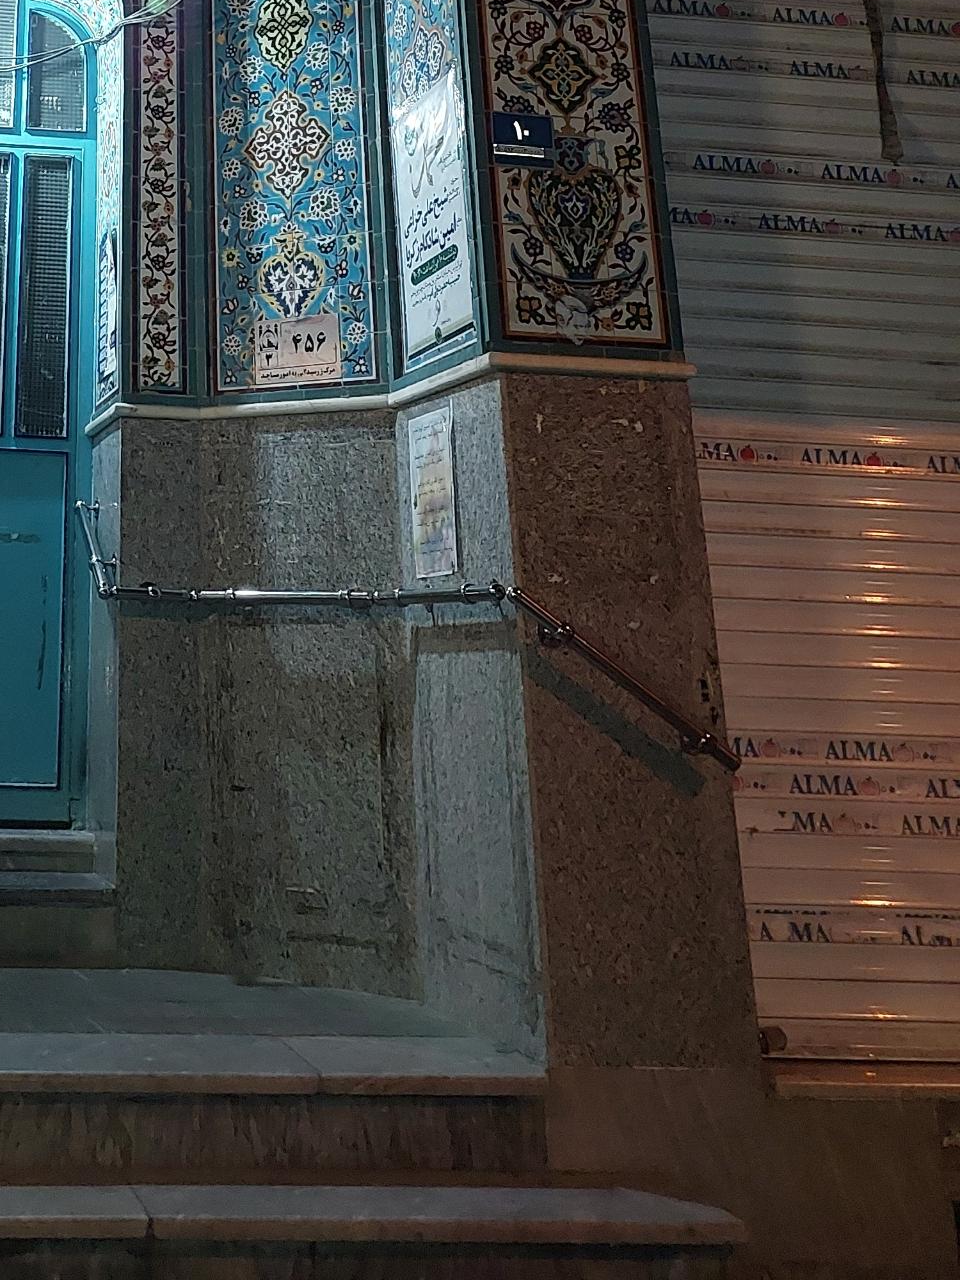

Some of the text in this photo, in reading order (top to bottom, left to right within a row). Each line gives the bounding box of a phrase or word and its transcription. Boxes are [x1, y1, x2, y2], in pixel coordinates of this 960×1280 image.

[772, 7, 834, 26] ALMA
[891, 16, 949, 35] ALMA
[669, 51, 730, 70] ALMA
[790, 60, 849, 79] ALMA
[513, 120, 530, 140] ۱۰
[692, 153, 885, 183] ALMA ALMA
[758, 213, 821, 233] ALMA
[884, 223, 947, 241] ALMA
[292, 331, 326, 354] ۴۵۶
[265, 352, 273, 366] ۳
[800, 447, 864, 466] ALMA
[824, 740, 893, 762] ALMA
[789, 774, 858, 796] ALMA
[760, 921, 831, 943] AMA
